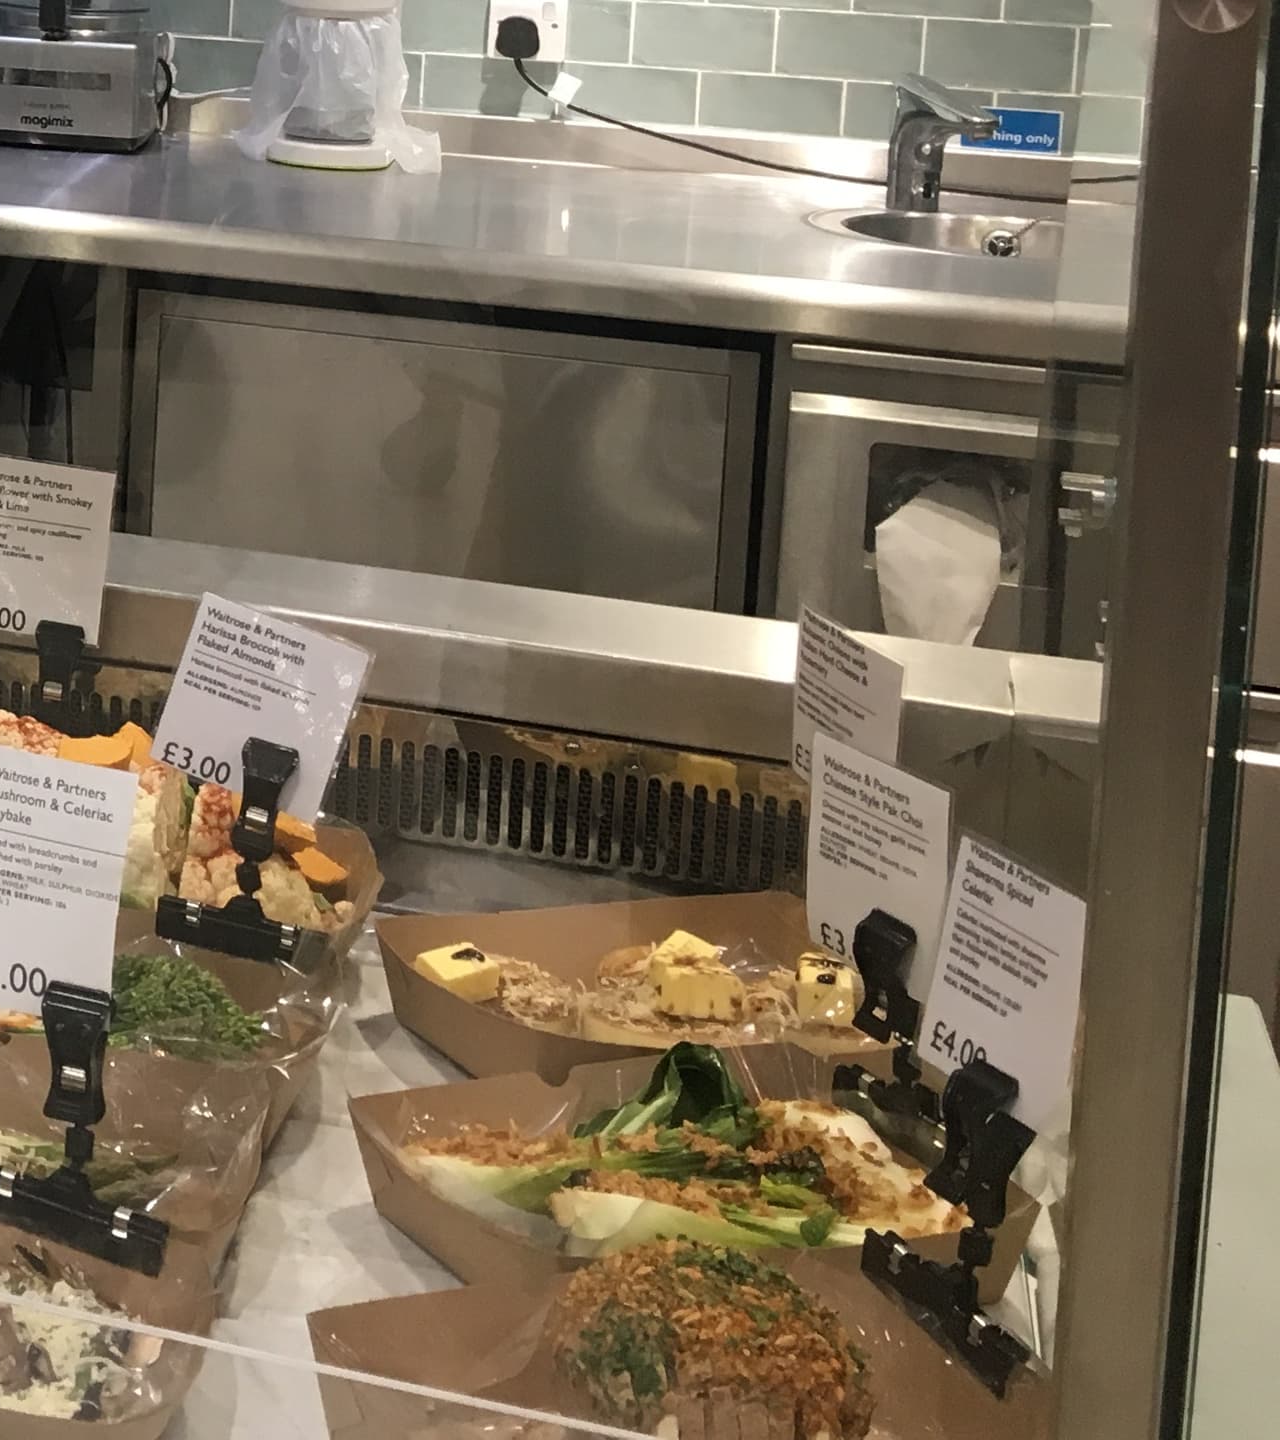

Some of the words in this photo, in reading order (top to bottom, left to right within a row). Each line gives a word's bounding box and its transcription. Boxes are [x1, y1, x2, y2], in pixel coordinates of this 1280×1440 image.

[19, 114, 74, 129] magimix
[991, 129, 1022, 146] hing
[1025, 131, 1056, 147] only
[23, 475, 31, 485] &
[33, 475, 73, 491] Partners
[32, 491, 54, 503] with
[55, 493, 93, 511] Smokey
[201, 620, 237, 642] Harissa
[239, 634, 281, 657] Broccoli
[282, 651, 305, 666] with
[207, 606, 252, 631] Waitrose
[253, 624, 263, 635] &
[264, 627, 307, 651] Partners
[197, 633, 230, 653] Flaked
[230, 647, 276, 671] Almonds
[161, 741, 232, 785] £3.00
[42, 776, 52, 790] &
[56, 778, 107, 801] Partners
[823, 754, 862, 783] Waitrose
[864, 773, 871, 787] &
[873, 777, 910, 805] Partners
[823, 771, 857, 798] Chinese
[859, 789, 880, 810] Style
[882, 799, 899, 818] Pak
[49, 798, 59, 812] &
[63, 800, 114, 824] Celeriac
